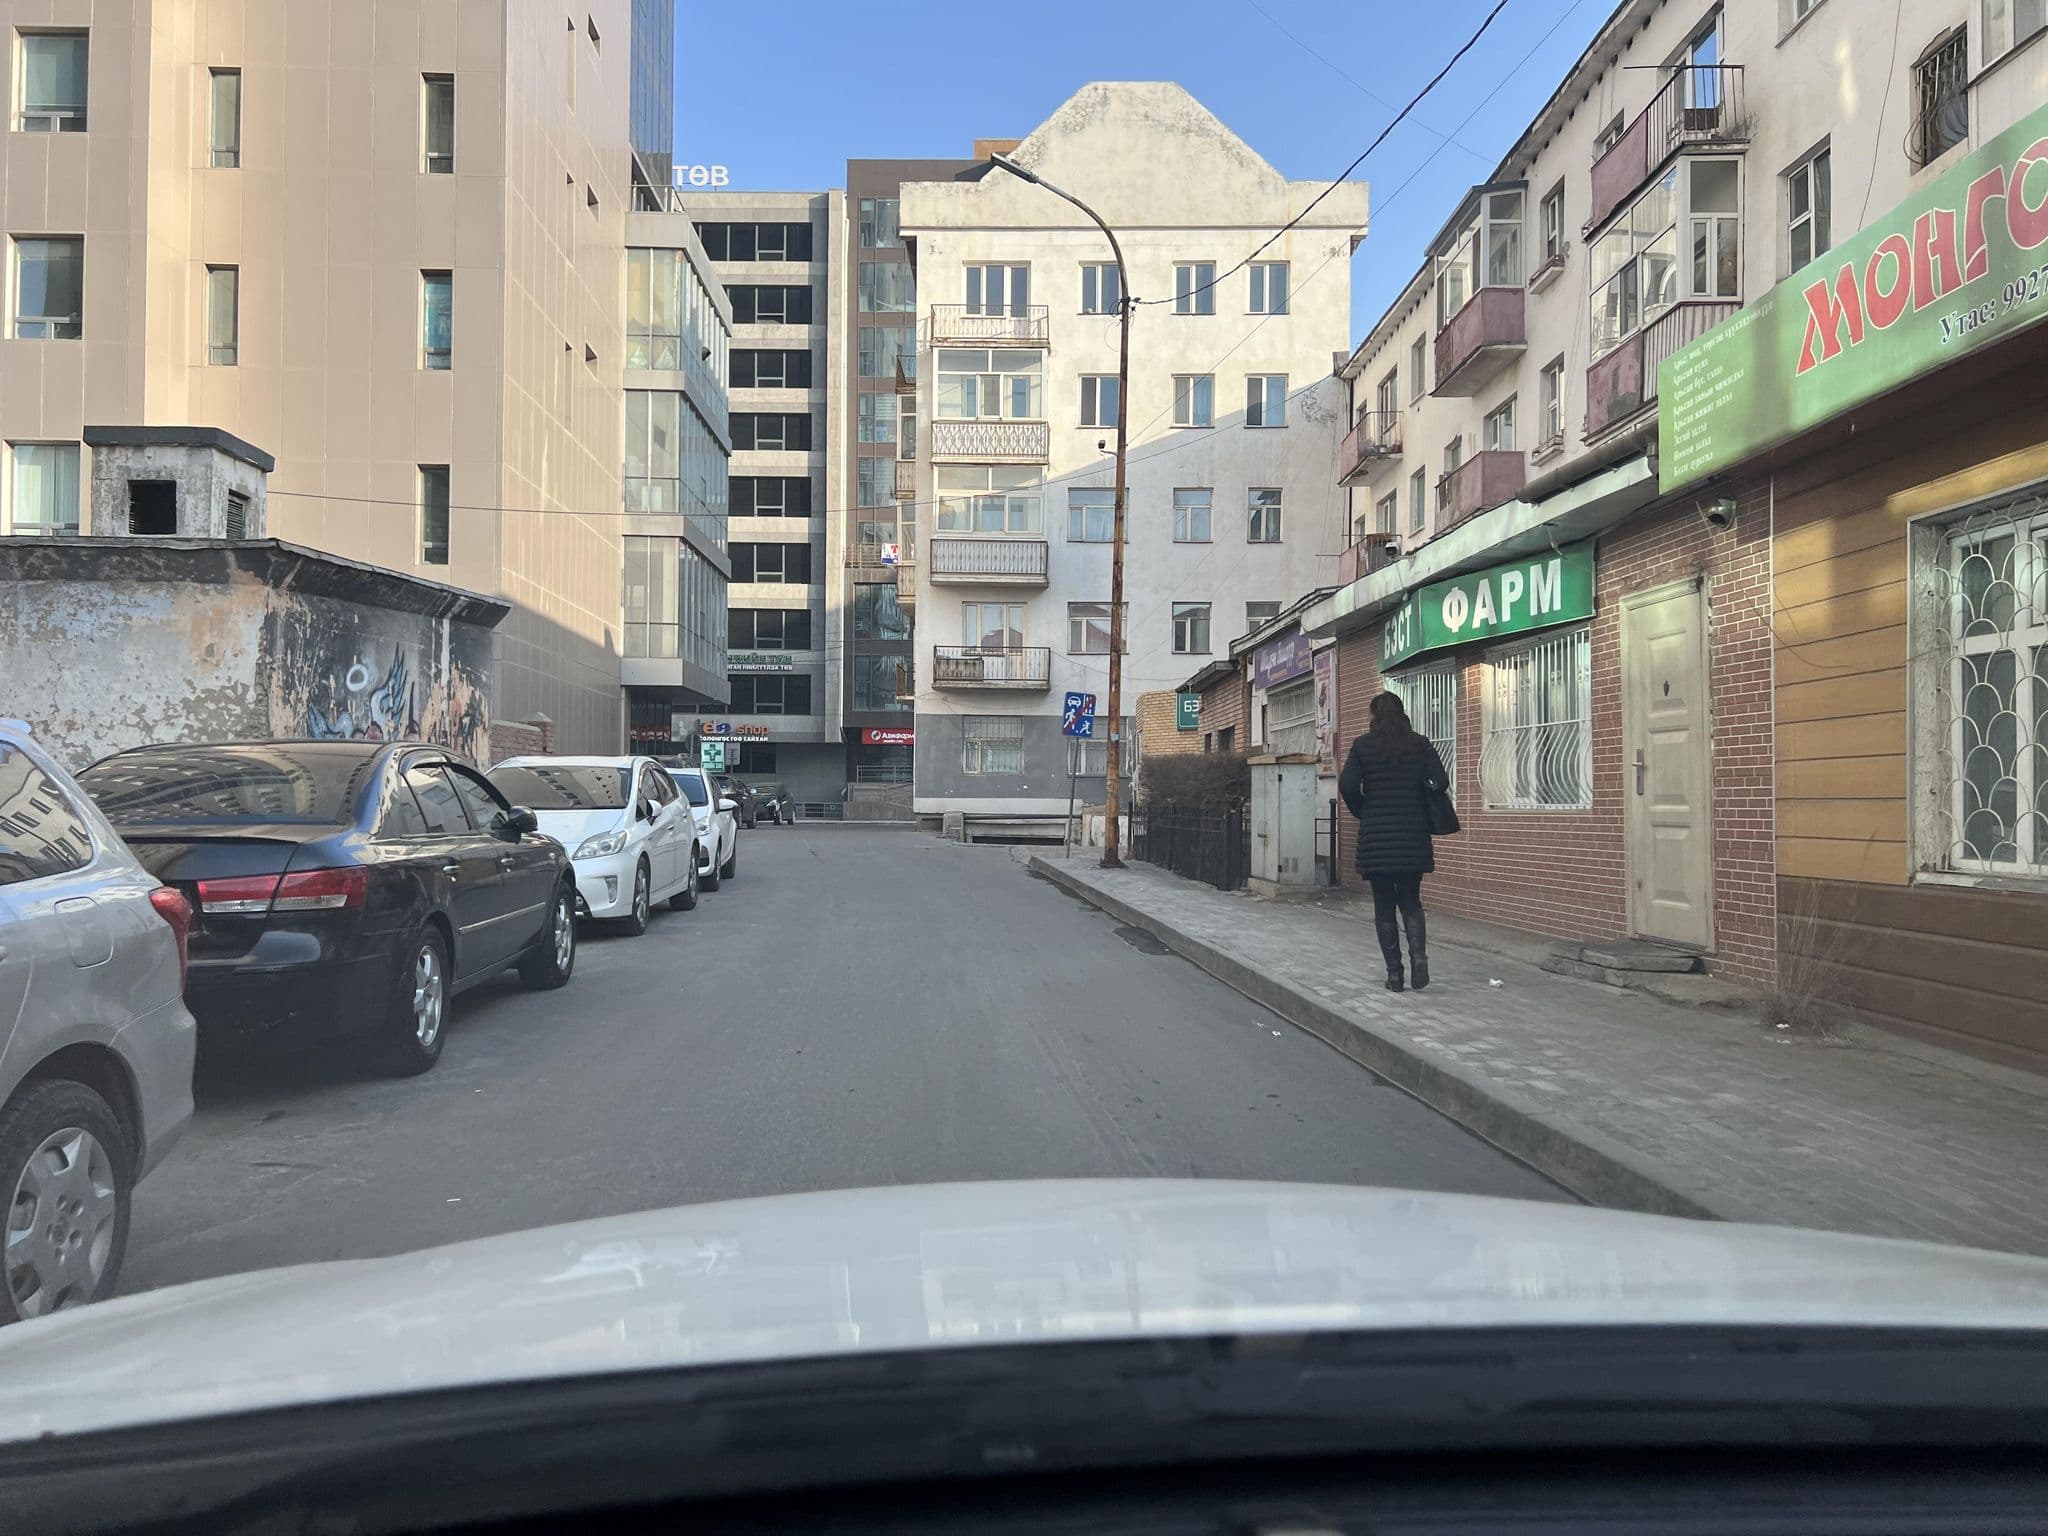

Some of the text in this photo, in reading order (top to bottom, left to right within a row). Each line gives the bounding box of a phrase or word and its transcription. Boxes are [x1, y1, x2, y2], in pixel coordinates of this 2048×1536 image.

[672, 165, 729, 187] ТӨВ
[1939, 299, 1996, 344] Утас:
[1384, 559, 1562, 661] БЭСТ ФАРМ
[736, 724, 769, 735] shop
